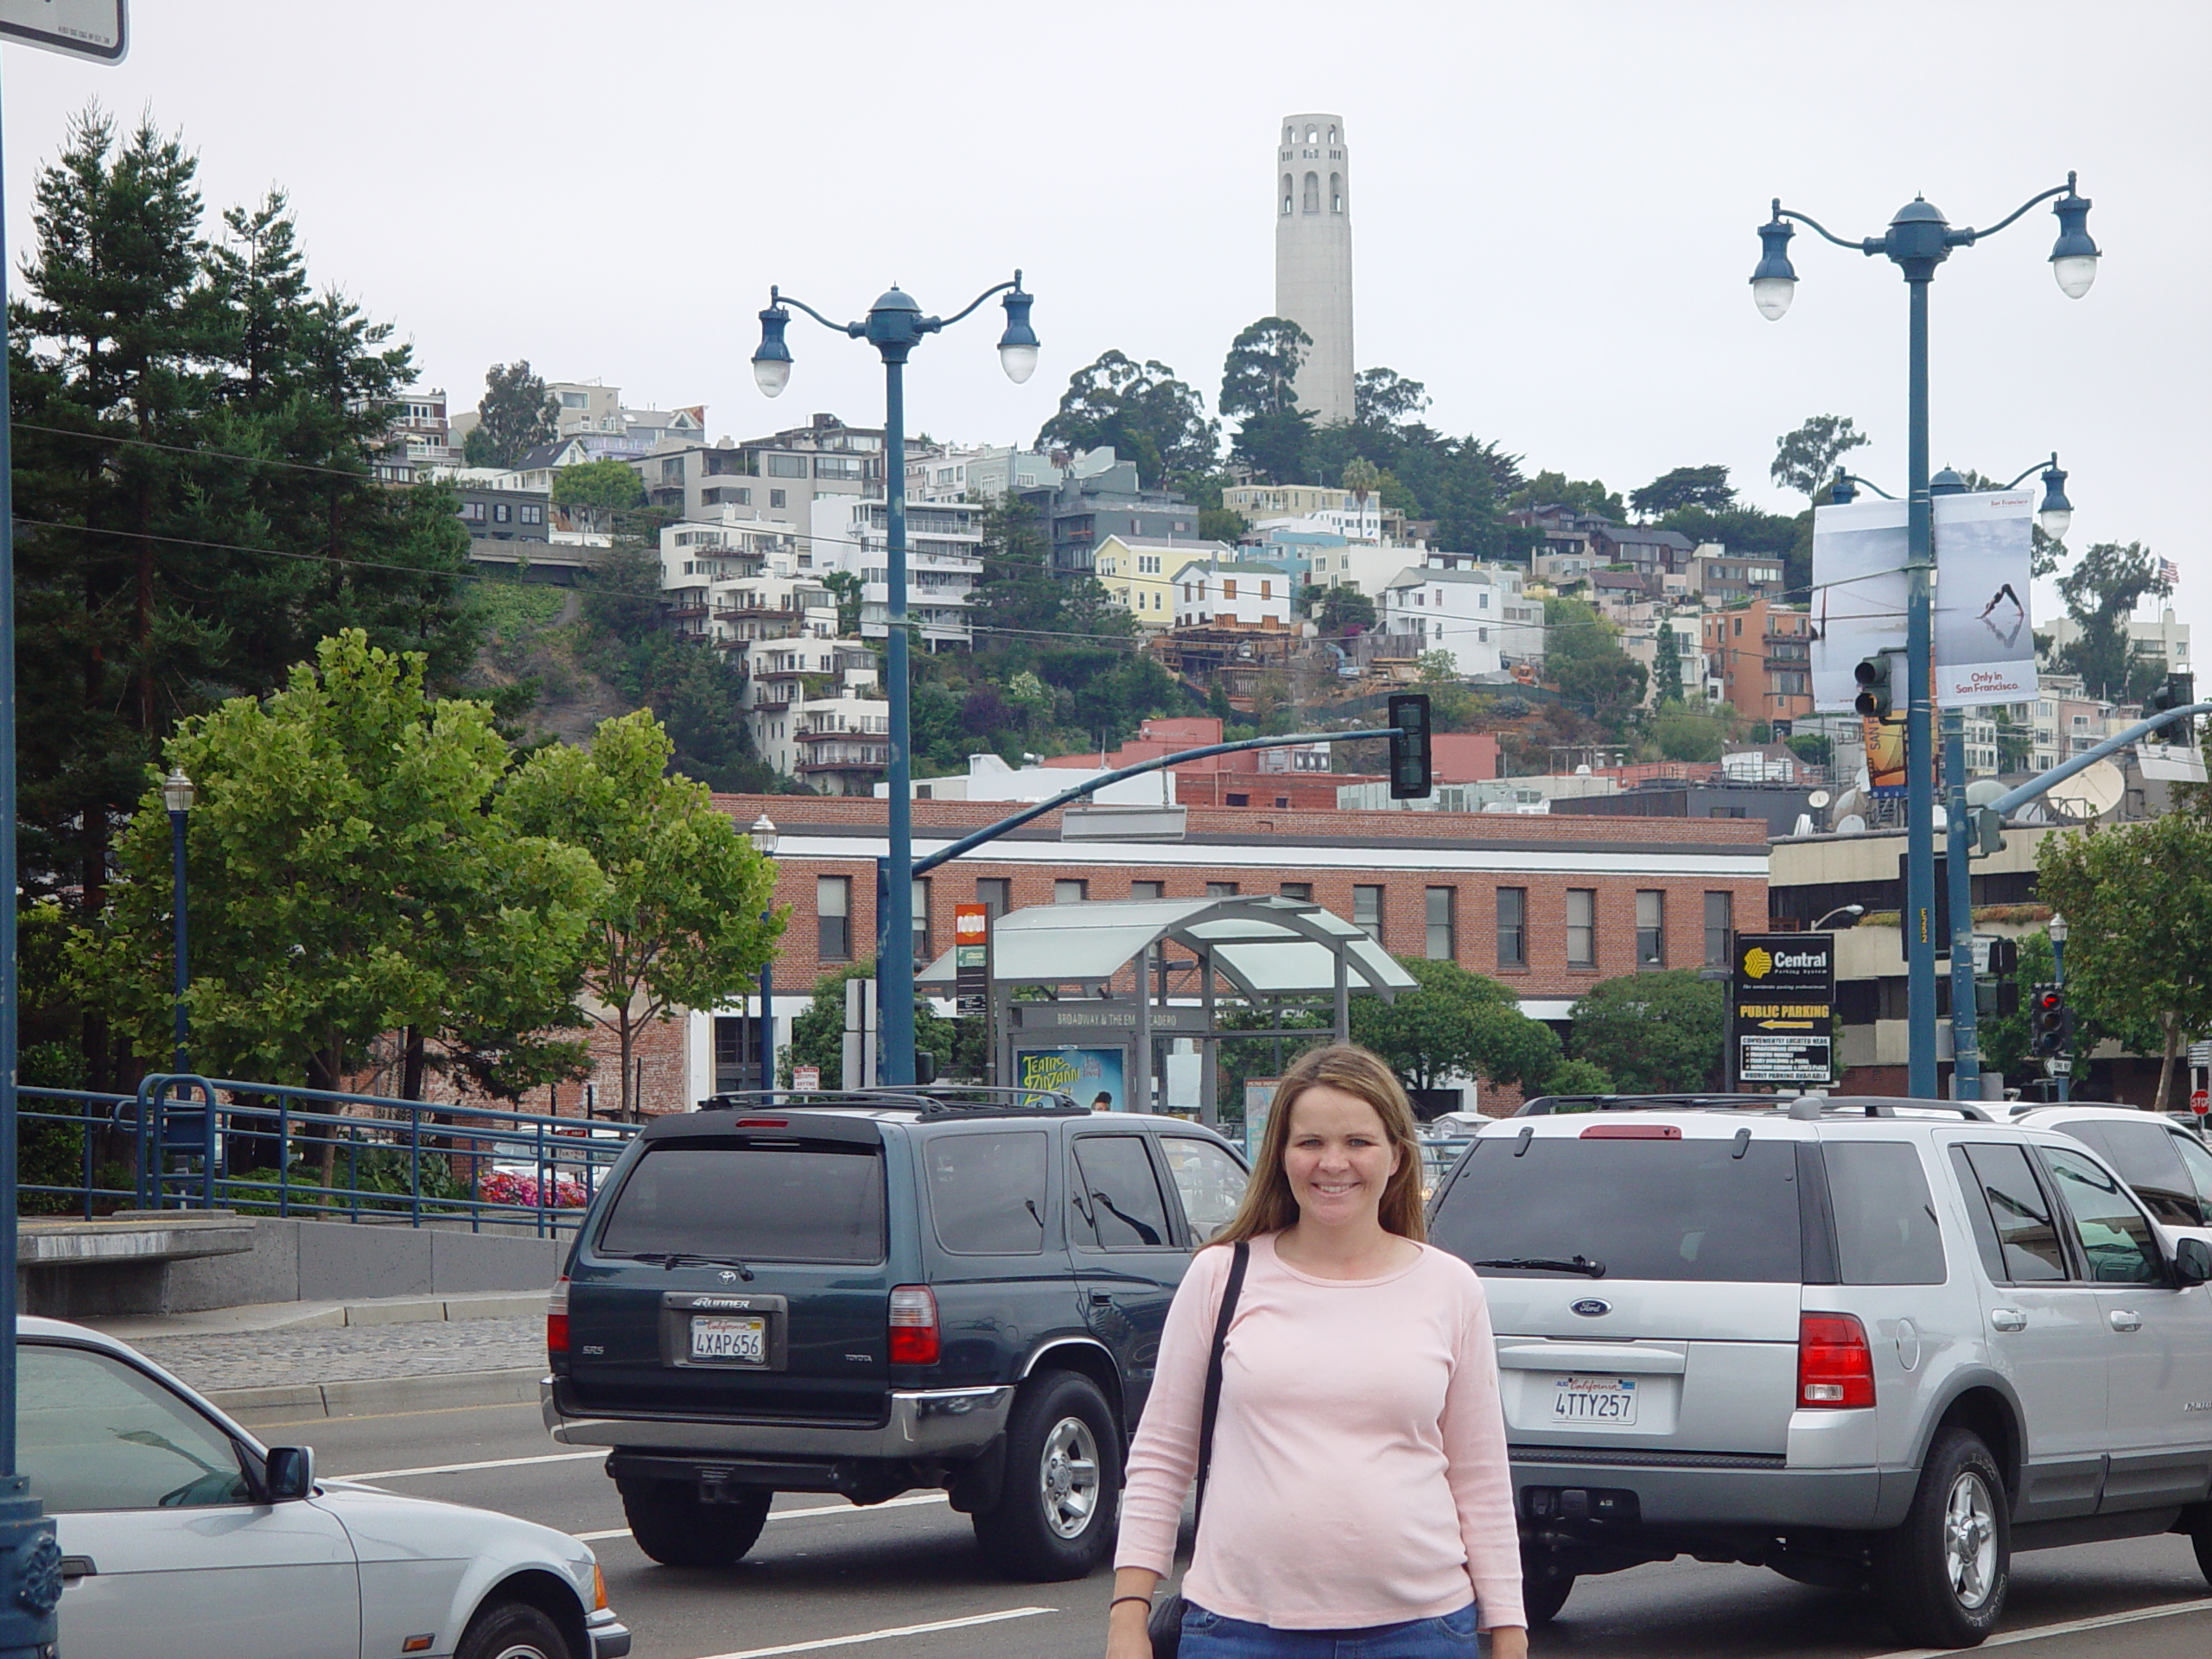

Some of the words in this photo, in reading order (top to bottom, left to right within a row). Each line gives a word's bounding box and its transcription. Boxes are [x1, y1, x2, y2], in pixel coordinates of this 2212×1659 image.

[1971, 672, 1993, 683] Only
[1994, 671, 2003, 680] in
[1955, 683, 1974, 694] San
[1869, 727, 1881, 751] SAN
[1774, 951, 1827, 968] Central
[1740, 1005, 1780, 1018] PUBLIC
[1781, 1005, 1829, 1018] PARKING
[1058, 1013, 1099, 1025] BROADWAY
[1101, 1014, 1107, 1025] &
[1109, 1014, 1122, 1026] THE
[1022, 1055, 1070, 1076] TEATRO
[1023, 1066, 1080, 1106] ZINZANNI
[2191, 1096, 2209, 1108] STOP
[1580, 1302, 1601, 1313] Ford
[707, 1321, 751, 1333] California
[696, 1333, 760, 1355] 4XAP656
[1570, 1379, 1623, 1394] California
[1555, 1393, 1631, 1417] 4TTY257
